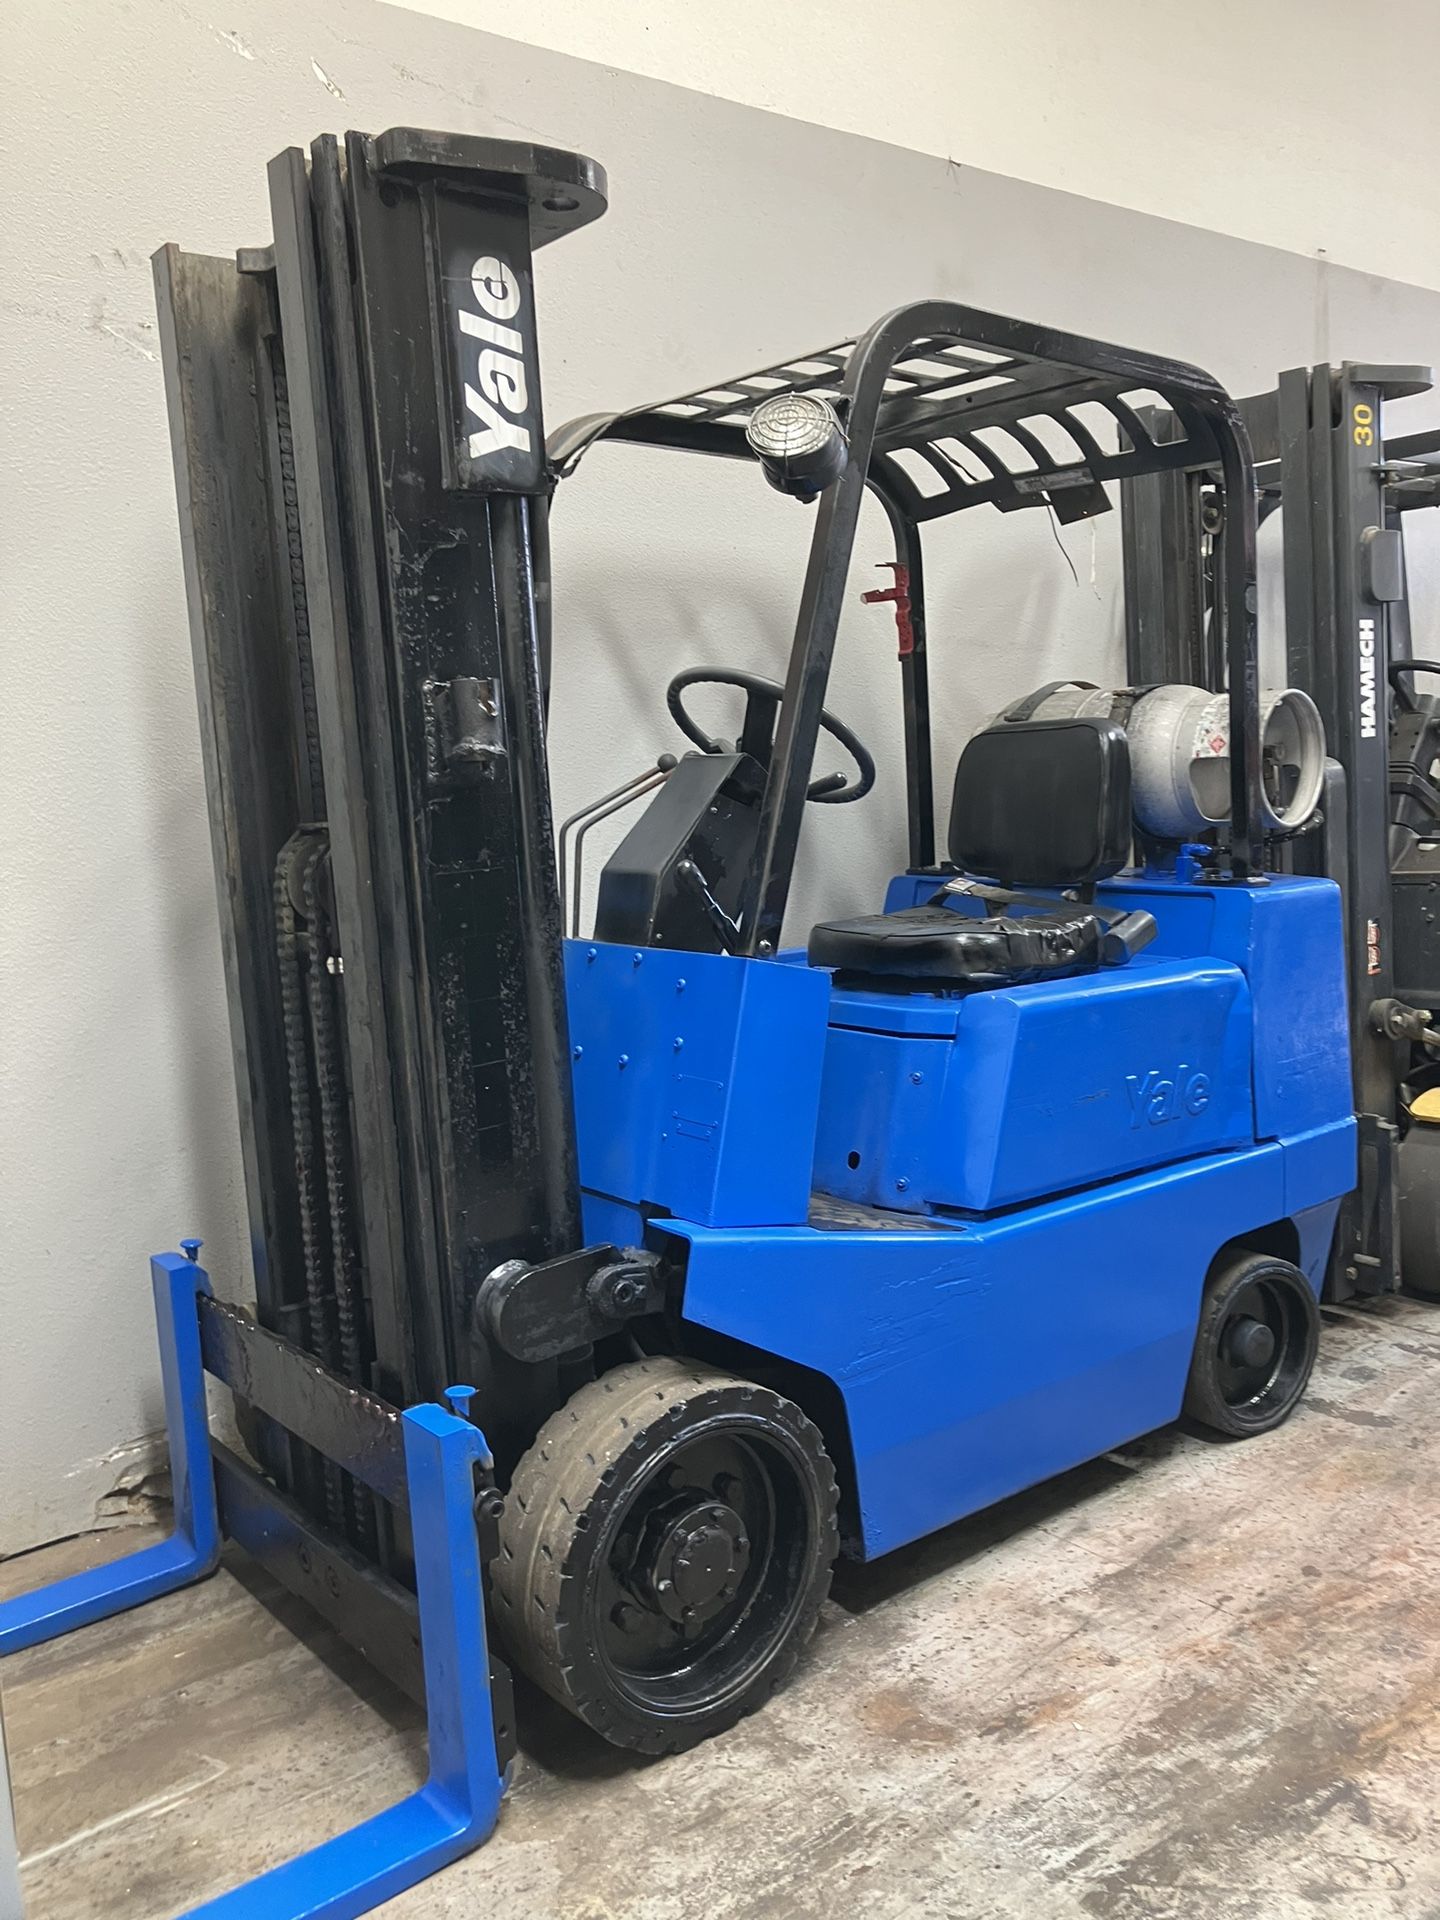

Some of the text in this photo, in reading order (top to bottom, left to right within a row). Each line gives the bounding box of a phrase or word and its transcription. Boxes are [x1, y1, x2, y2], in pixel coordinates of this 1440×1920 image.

[458, 256, 531, 458] Yale
[1353, 403, 1373, 446] 30
[1359, 619, 1377, 738] HAMECH
[1126, 1064, 1210, 1129] Yale
